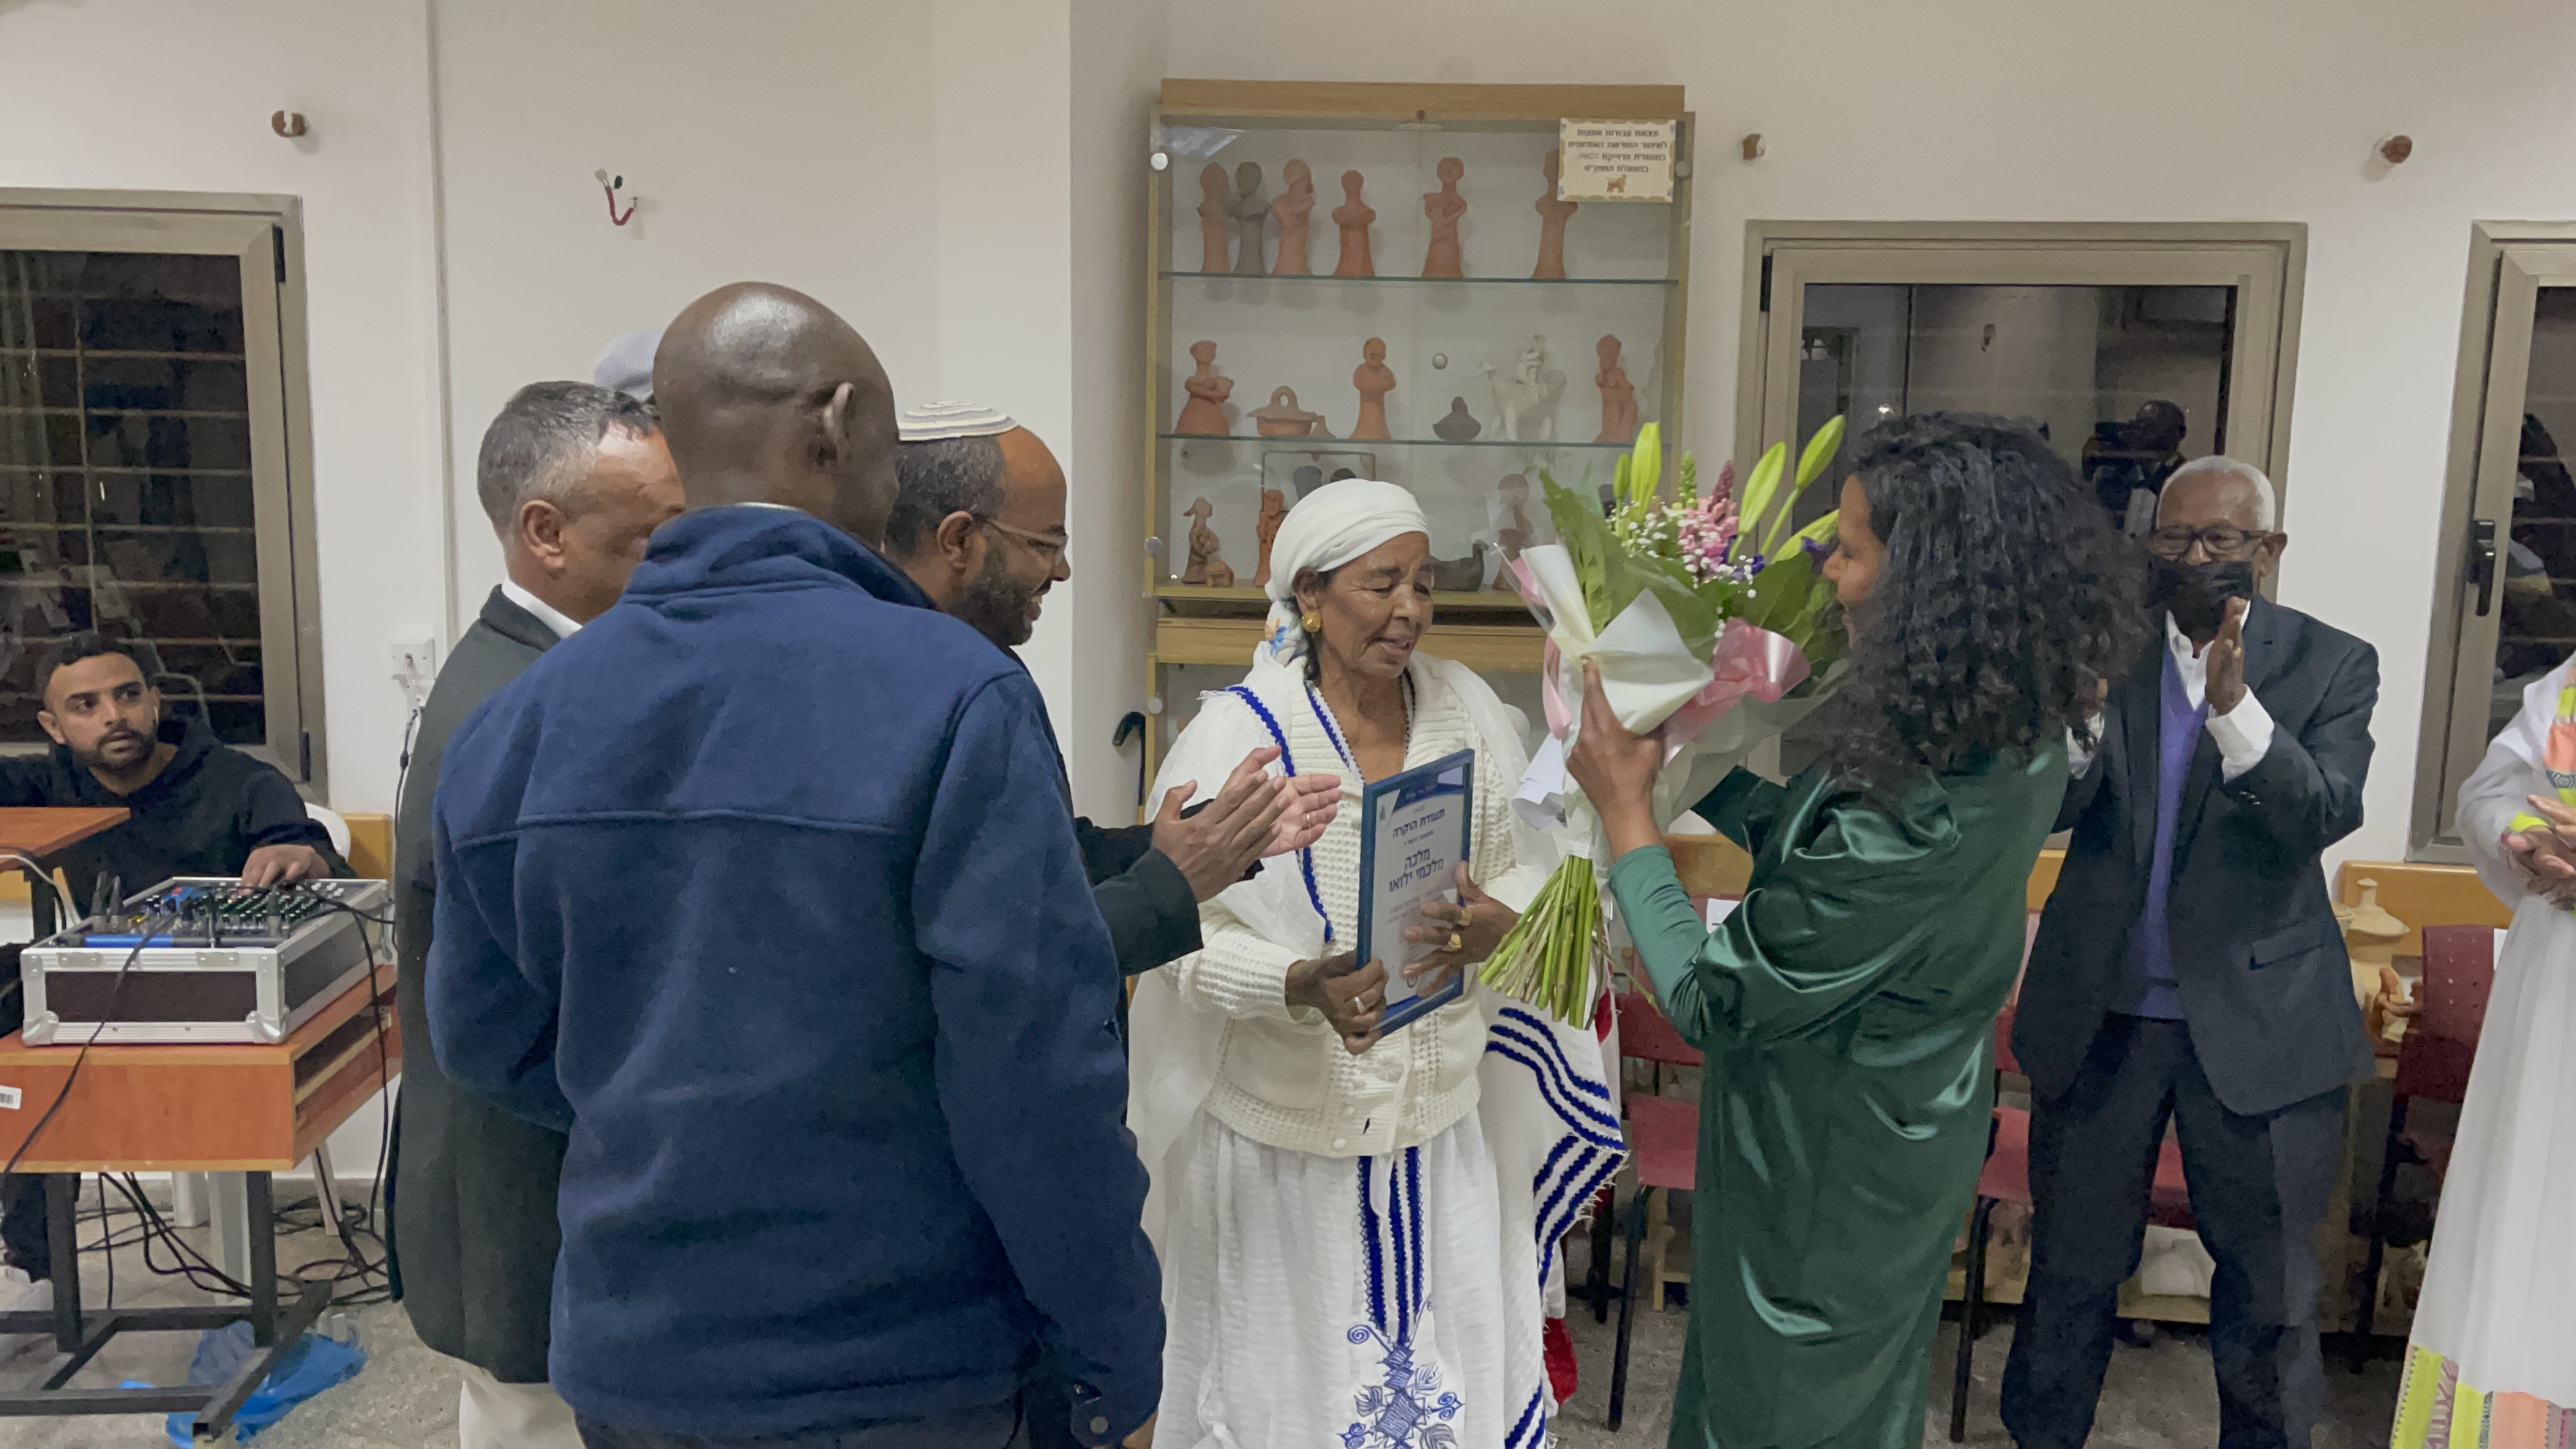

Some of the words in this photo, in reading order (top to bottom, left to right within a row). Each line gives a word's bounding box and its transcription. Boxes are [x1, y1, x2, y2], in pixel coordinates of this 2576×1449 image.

[1633, 153, 1666, 161] במסגרת
[1420, 808, 1445, 828] תעודת
[1392, 819, 1418, 839] הוקרה
[1404, 847, 1431, 870] מלכה
